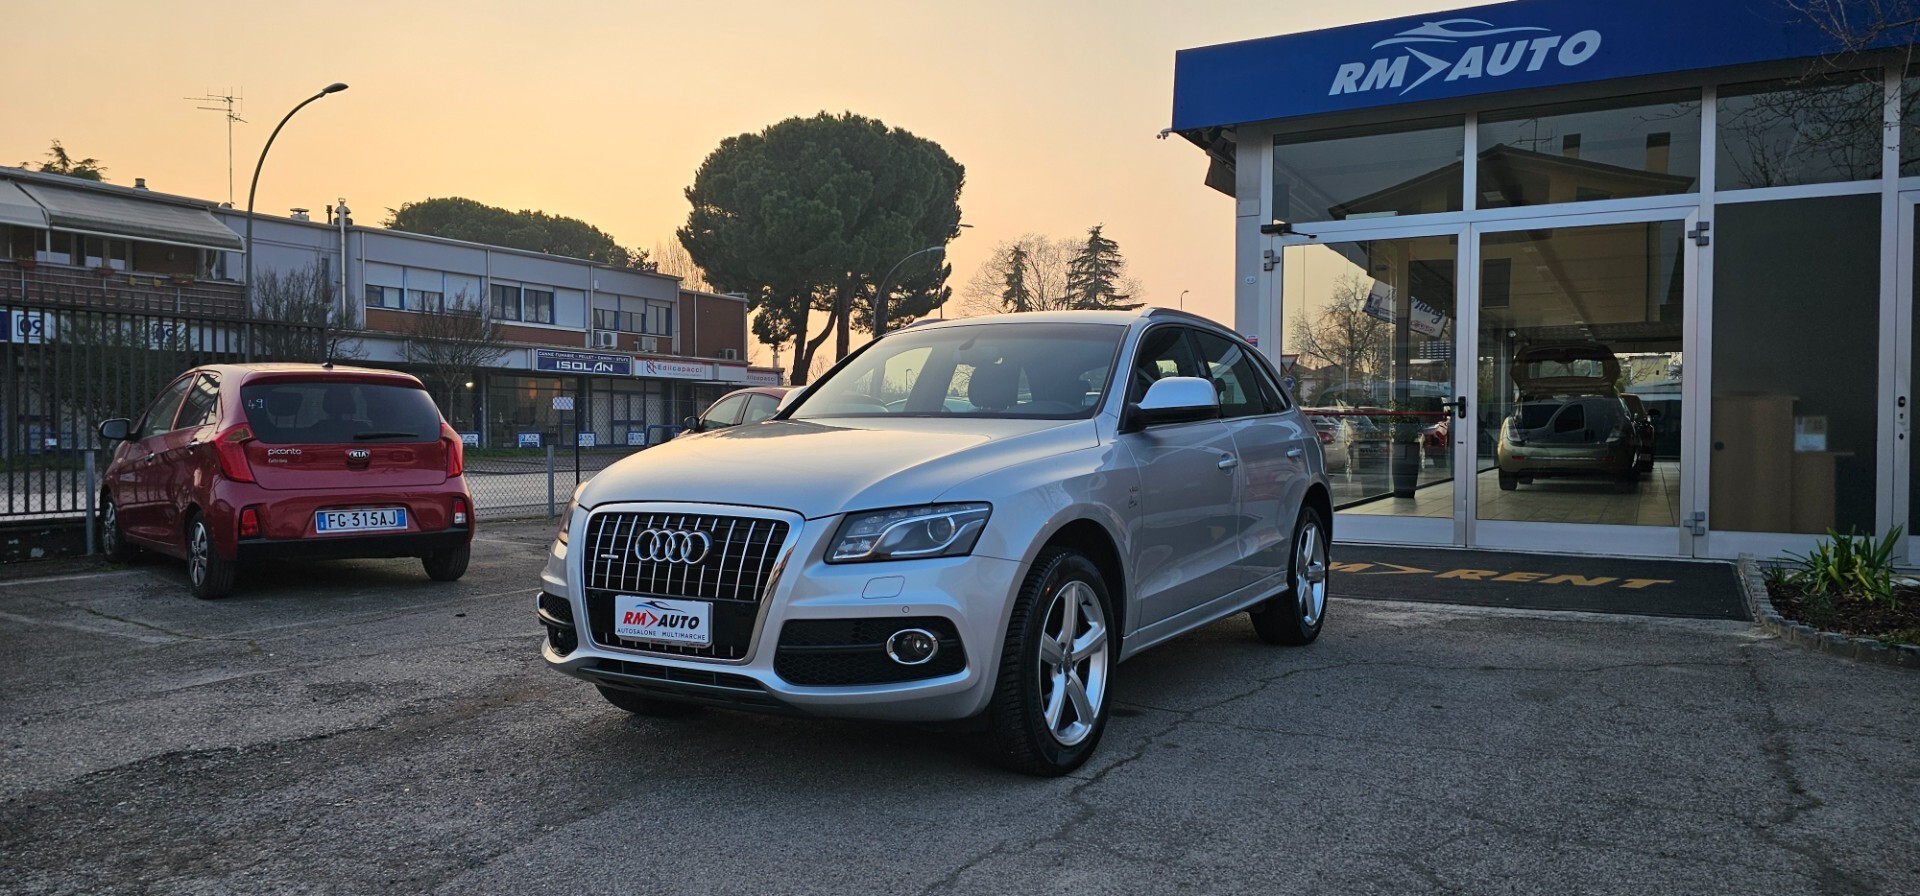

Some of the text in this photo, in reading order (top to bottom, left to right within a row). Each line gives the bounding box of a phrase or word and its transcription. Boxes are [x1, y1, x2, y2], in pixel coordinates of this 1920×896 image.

[1444, 29, 1602, 82] AUTO
[556, 360, 613, 373] ISOLAN
[267, 448, 302, 456] picanto
[352, 450, 367, 458] KIA
[1434, 568, 1675, 589] RENT
[657, 613, 700, 630] AUTO
[616, 628, 706, 640] AUTOSALONE MULTIMARCHE
